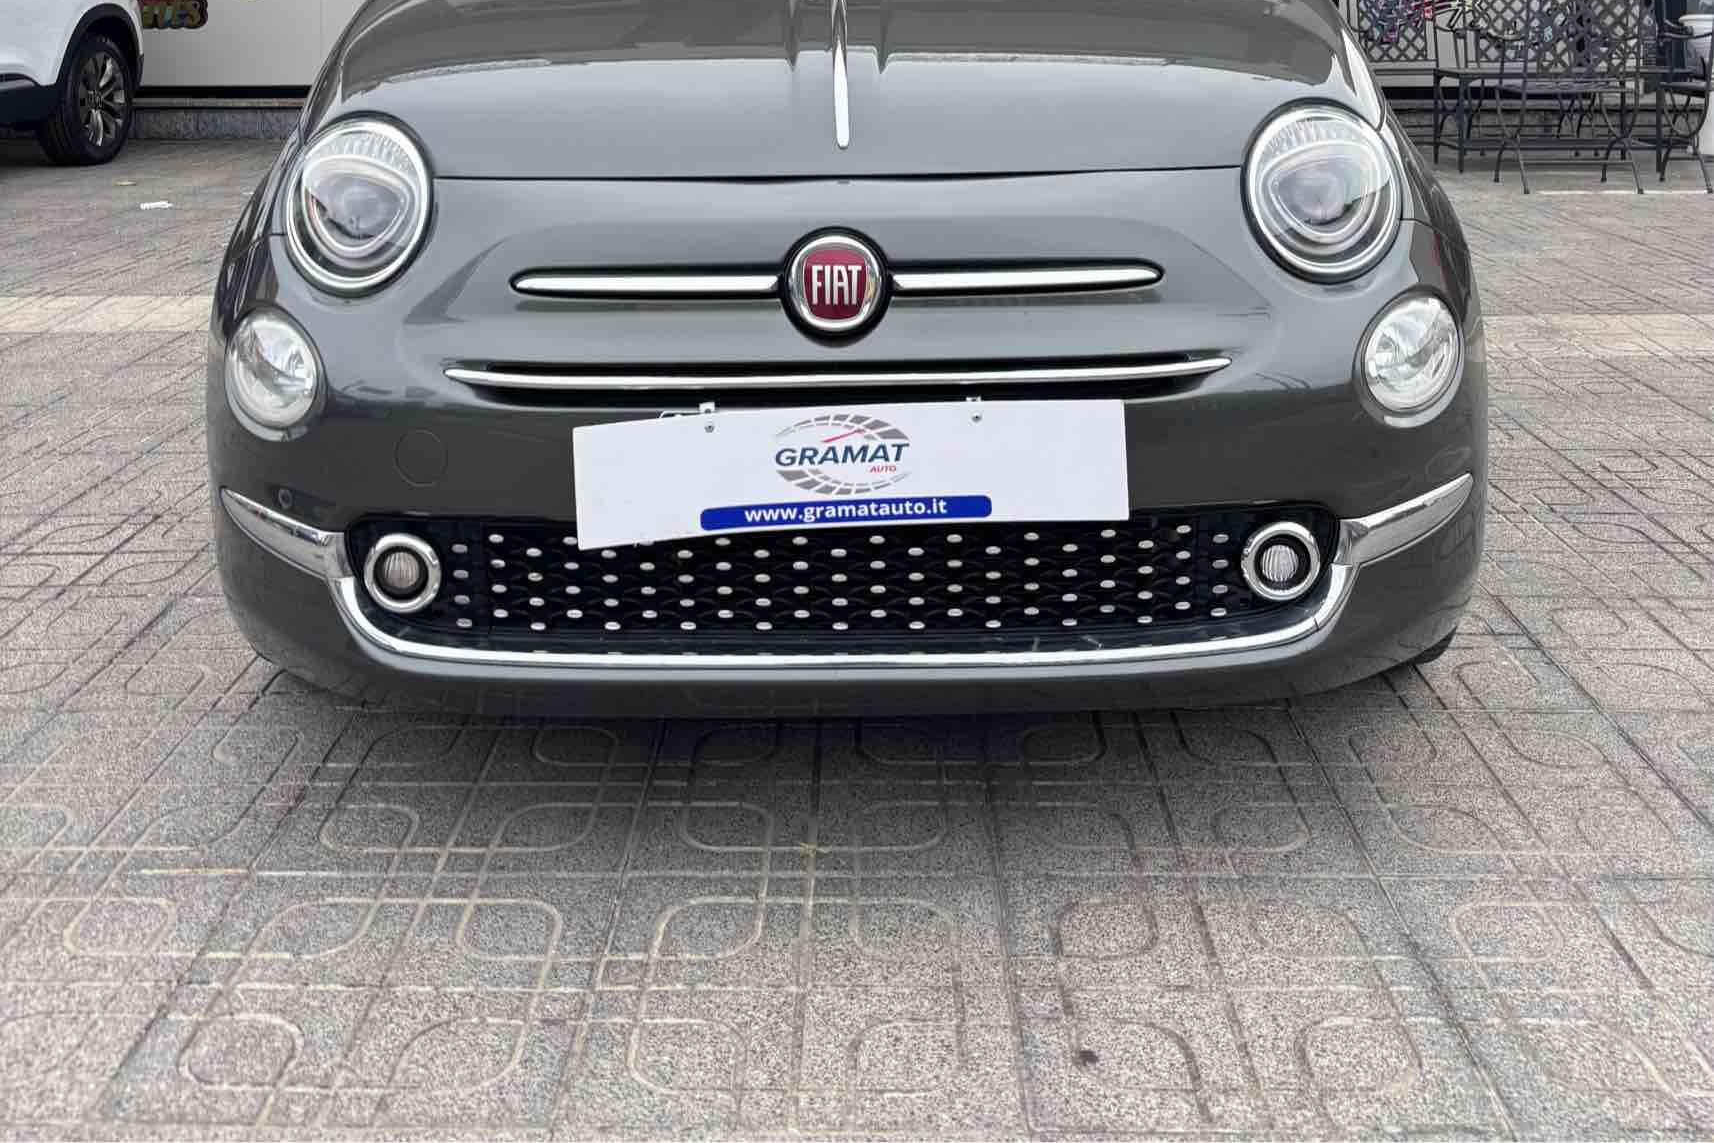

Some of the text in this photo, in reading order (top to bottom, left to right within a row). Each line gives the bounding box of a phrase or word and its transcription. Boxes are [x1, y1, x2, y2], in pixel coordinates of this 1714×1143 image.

[811, 265, 862, 305] FIAT
[775, 443, 910, 467] GRAMAT
[869, 465, 897, 473] AUTO
[744, 498, 948, 523] www.gramatauto.it
